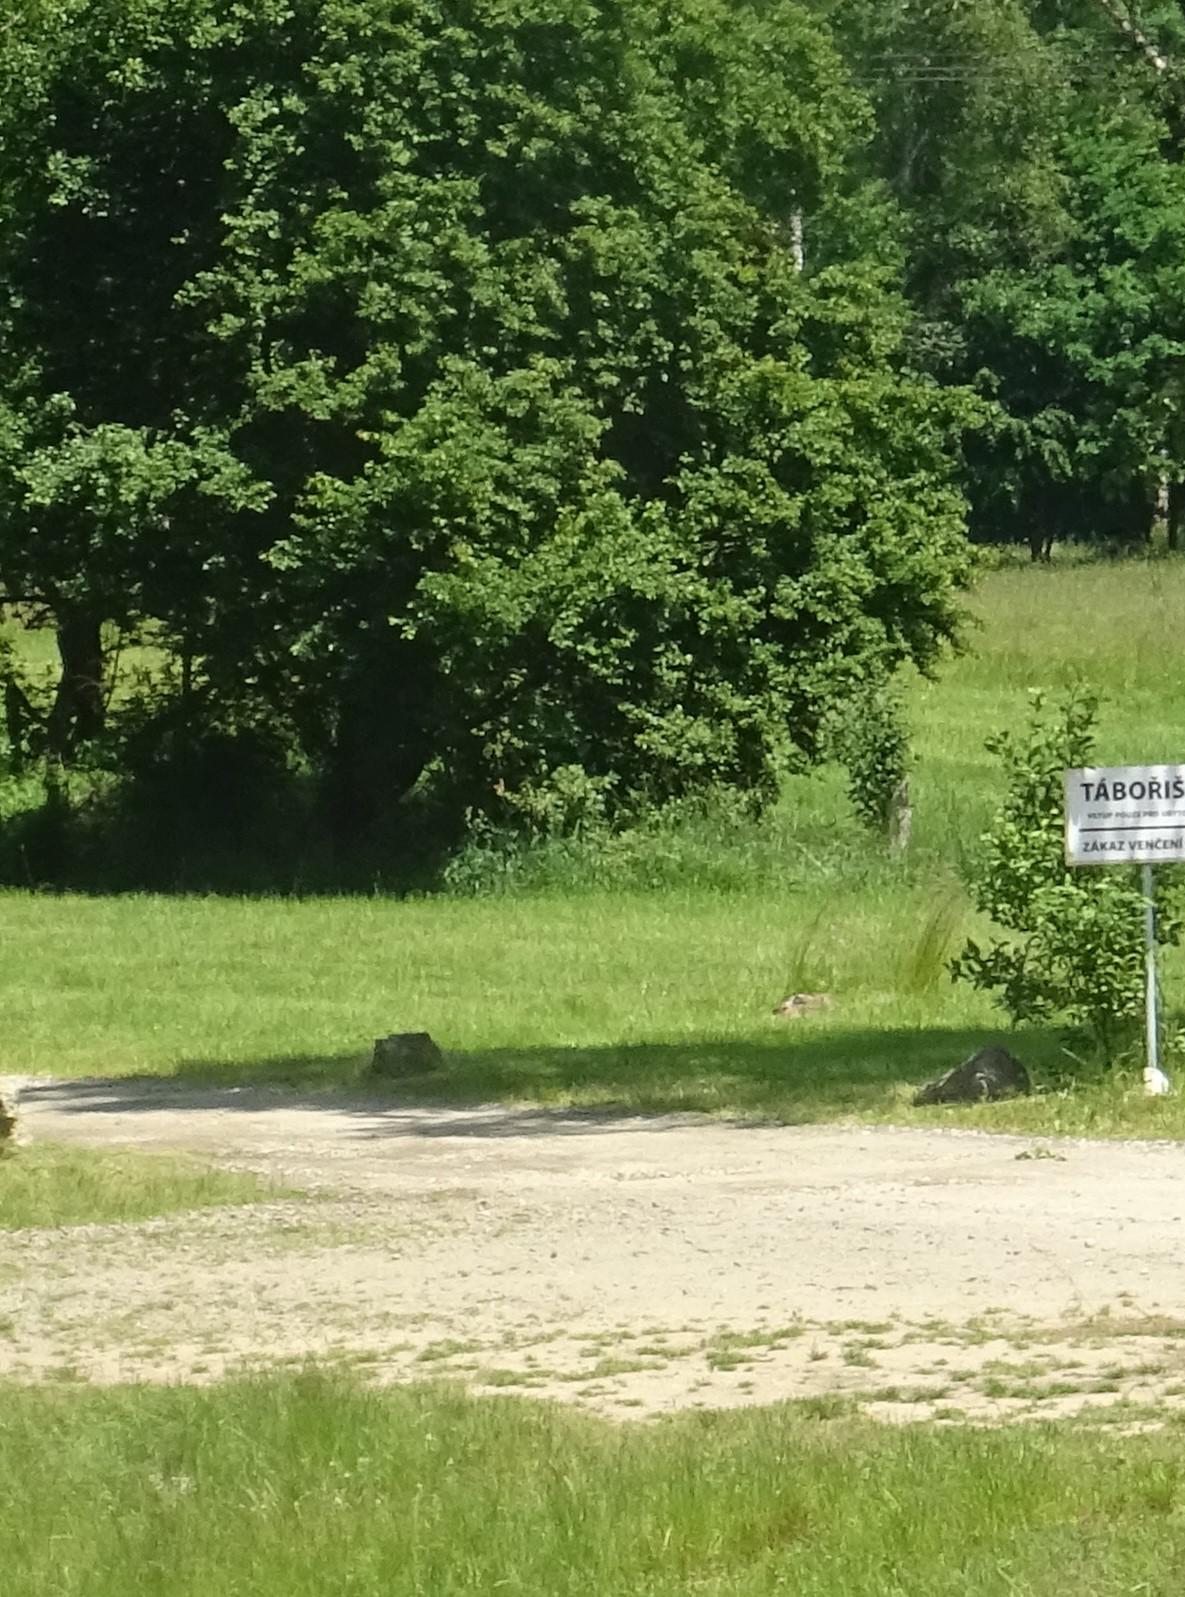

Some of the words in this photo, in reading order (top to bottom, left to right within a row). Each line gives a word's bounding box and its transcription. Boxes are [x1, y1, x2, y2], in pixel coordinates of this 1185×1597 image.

[1143, 809, 1159, 817] PRO
[1083, 840, 1125, 852] ZÁKAZ
[1128, 836, 1183, 851] VENČENÍ
